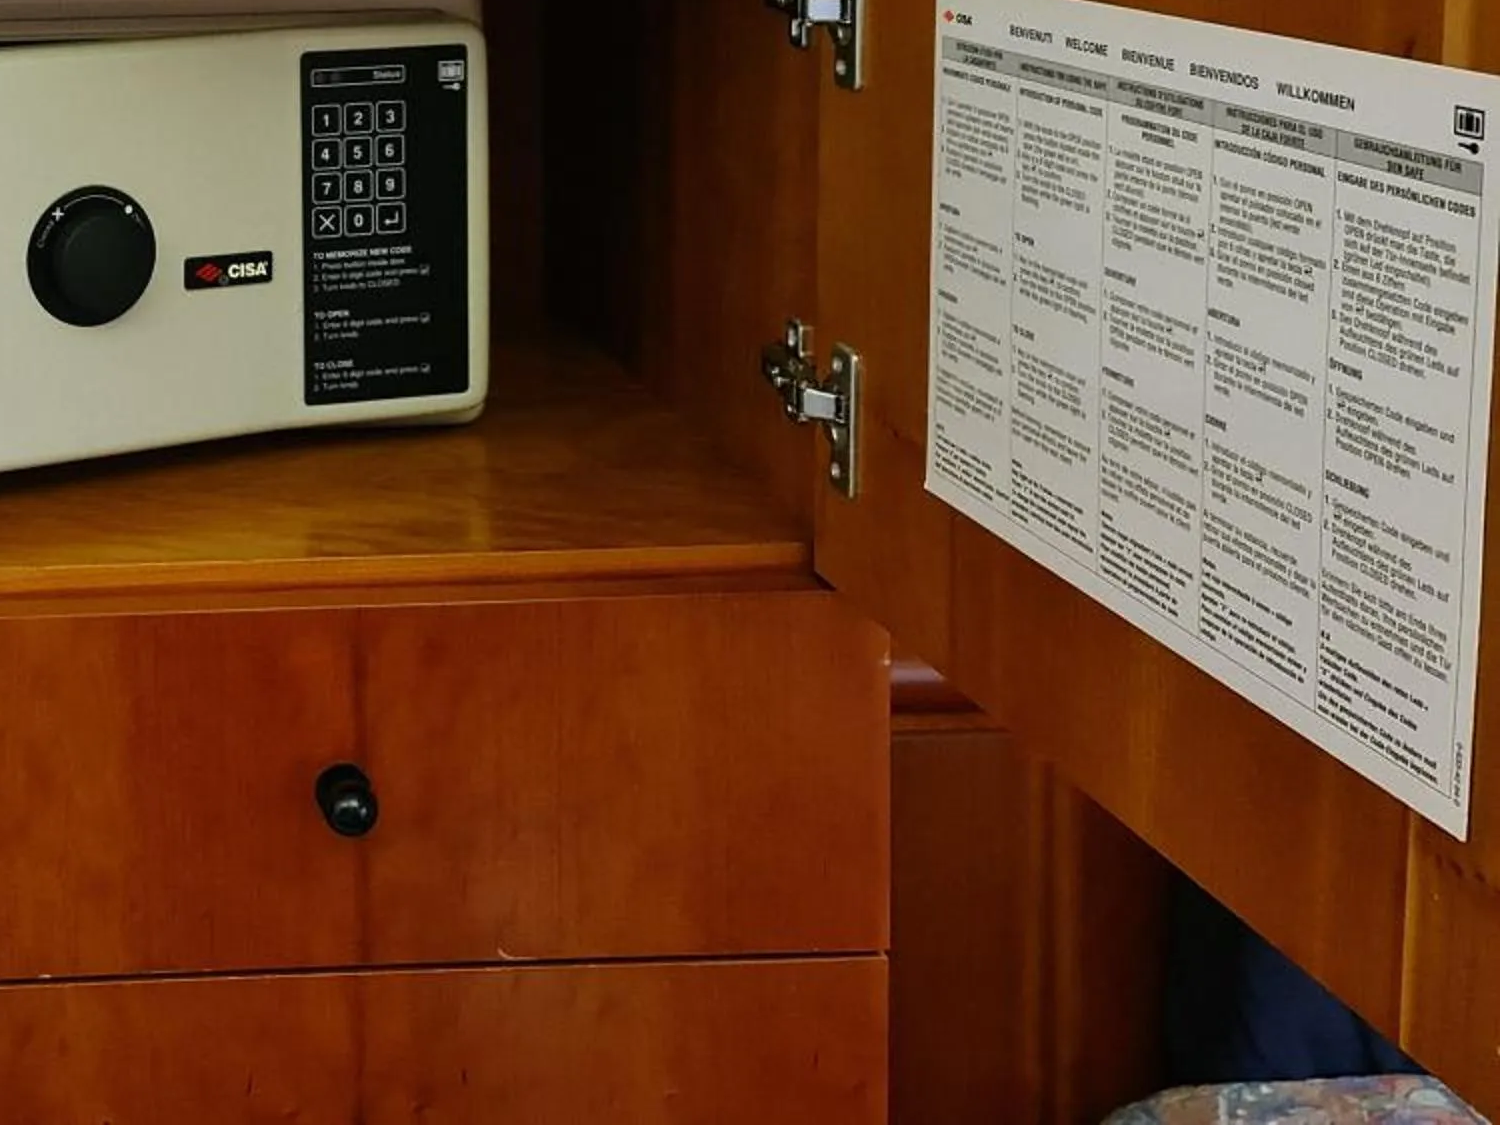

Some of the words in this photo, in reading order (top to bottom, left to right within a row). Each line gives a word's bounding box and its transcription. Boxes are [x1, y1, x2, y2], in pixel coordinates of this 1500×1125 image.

[1009, 24, 1052, 45] BENVENUTI
[1064, 35, 1108, 57] WELCOME
[1121, 47, 1174, 72] BIENVENUE
[1189, 62, 1259, 90] BIENVENIDOS
[1276, 81, 1355, 112] WILLKOMMEN
[322, 114, 330, 127] 1
[354, 112, 364, 125] 2
[386, 109, 395, 124] 3
[320, 147, 330, 161] 4
[353, 145, 363, 160] 5
[384, 143, 395, 157] 6
[322, 182, 332, 195] 7
[353, 180, 363, 194] 8
[385, 177, 395, 191] 9
[1337, 170, 1366, 188] EINGABE
[1369, 179, 1384, 193] DES
[1447, 199, 1475, 218] CODES
[353, 214, 363, 227] 0
[228, 264, 266, 278] CISA
